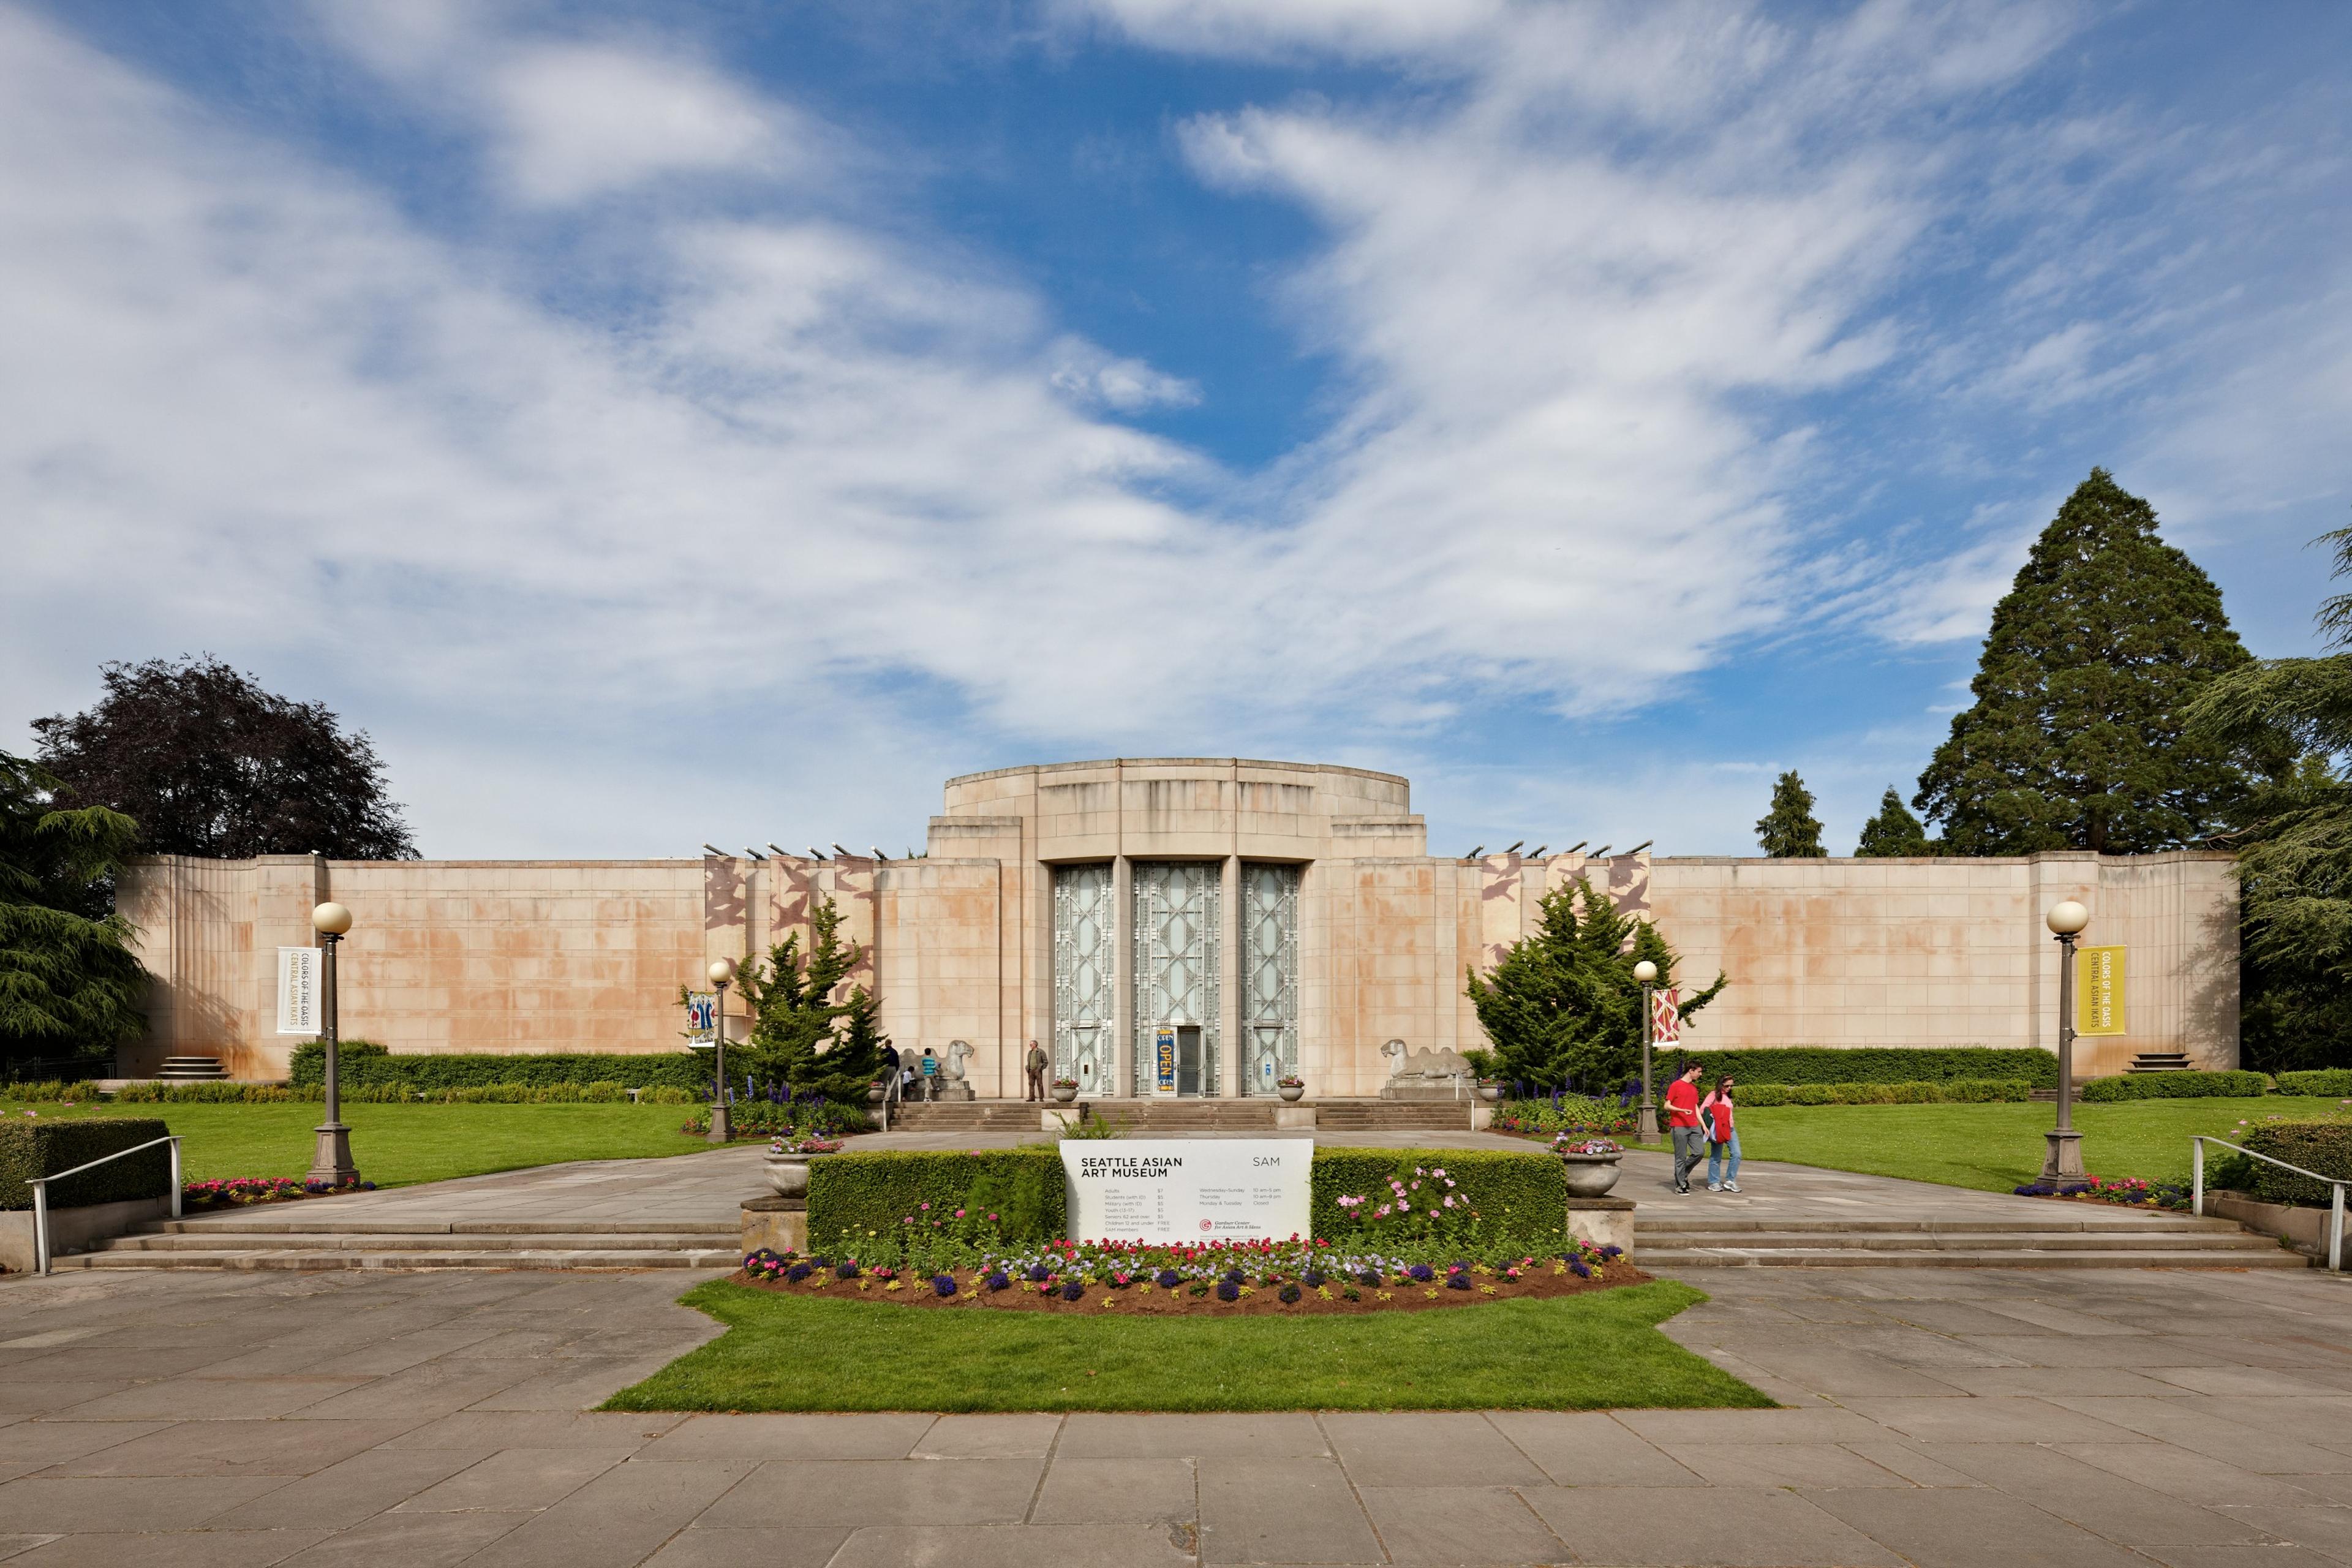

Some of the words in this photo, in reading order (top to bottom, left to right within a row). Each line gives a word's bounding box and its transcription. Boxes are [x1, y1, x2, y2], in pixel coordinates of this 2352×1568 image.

[2102, 952, 2111, 978] COLORS
[2102, 981, 2111, 989] OF
[2102, 992, 2111, 1005] THE
[2102, 1007, 2111, 1027] OASIS
[1159, 1045, 1172, 1075] OPEN
[1082, 1158, 1137, 1167] SEATTLE
[1142, 1158, 1182, 1167] ASIAN
[1253, 1157, 1280, 1166] SAM
[1082, 1169, 1107, 1178] ART
[1112, 1168, 1167, 1177] MUSEUM
